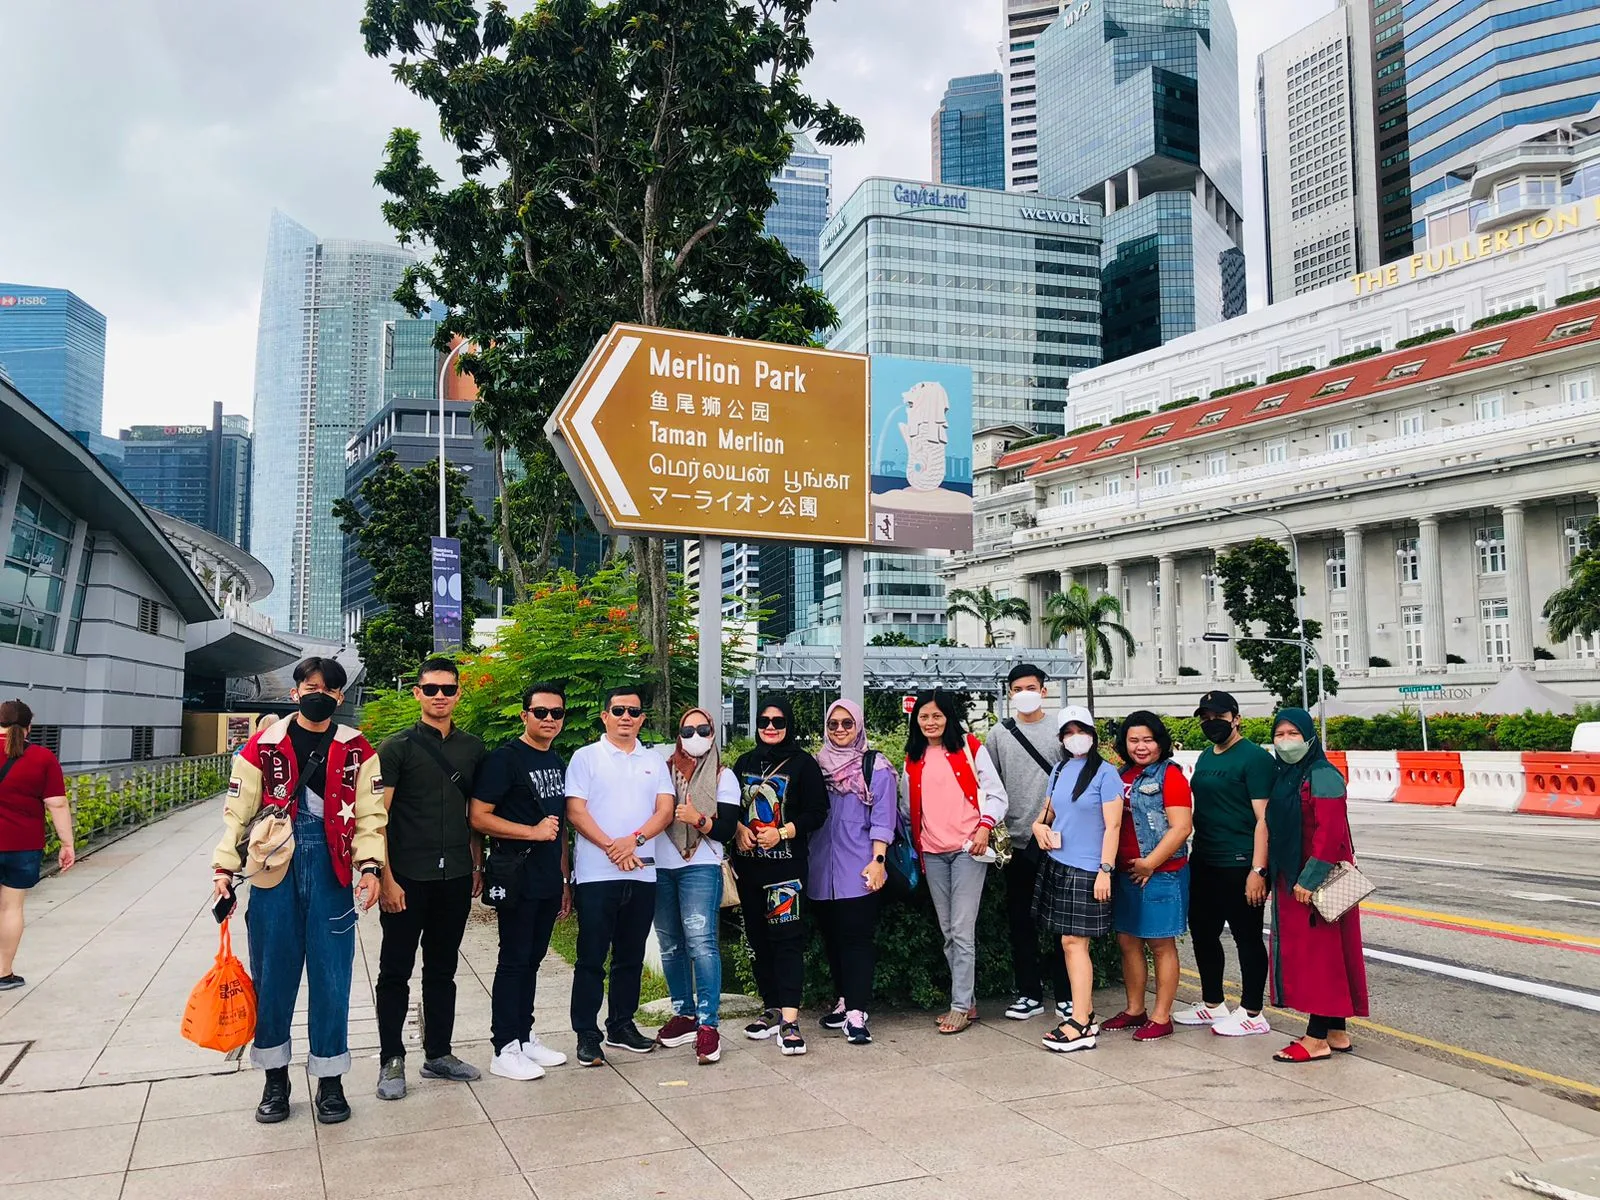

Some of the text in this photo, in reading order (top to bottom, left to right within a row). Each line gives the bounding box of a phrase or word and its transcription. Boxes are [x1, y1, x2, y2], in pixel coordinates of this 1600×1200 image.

[1063, 1, 1091, 29] MYP
[893, 183, 968, 210] CapitaLand
[1020, 207, 1091, 225] wework
[1350, 264, 1399, 296] THE
[1409, 206, 1579, 279] FULLERTON
[18, 296, 48, 305] HSBC
[650, 347, 806, 393] Merlion Park
[650, 390, 770, 423] 鱼尾狮公园
[649, 420, 784, 455] Taman Merlion
[784, 467, 850, 493] பூங்கா
[649, 486, 818, 518] マーライオン公園
